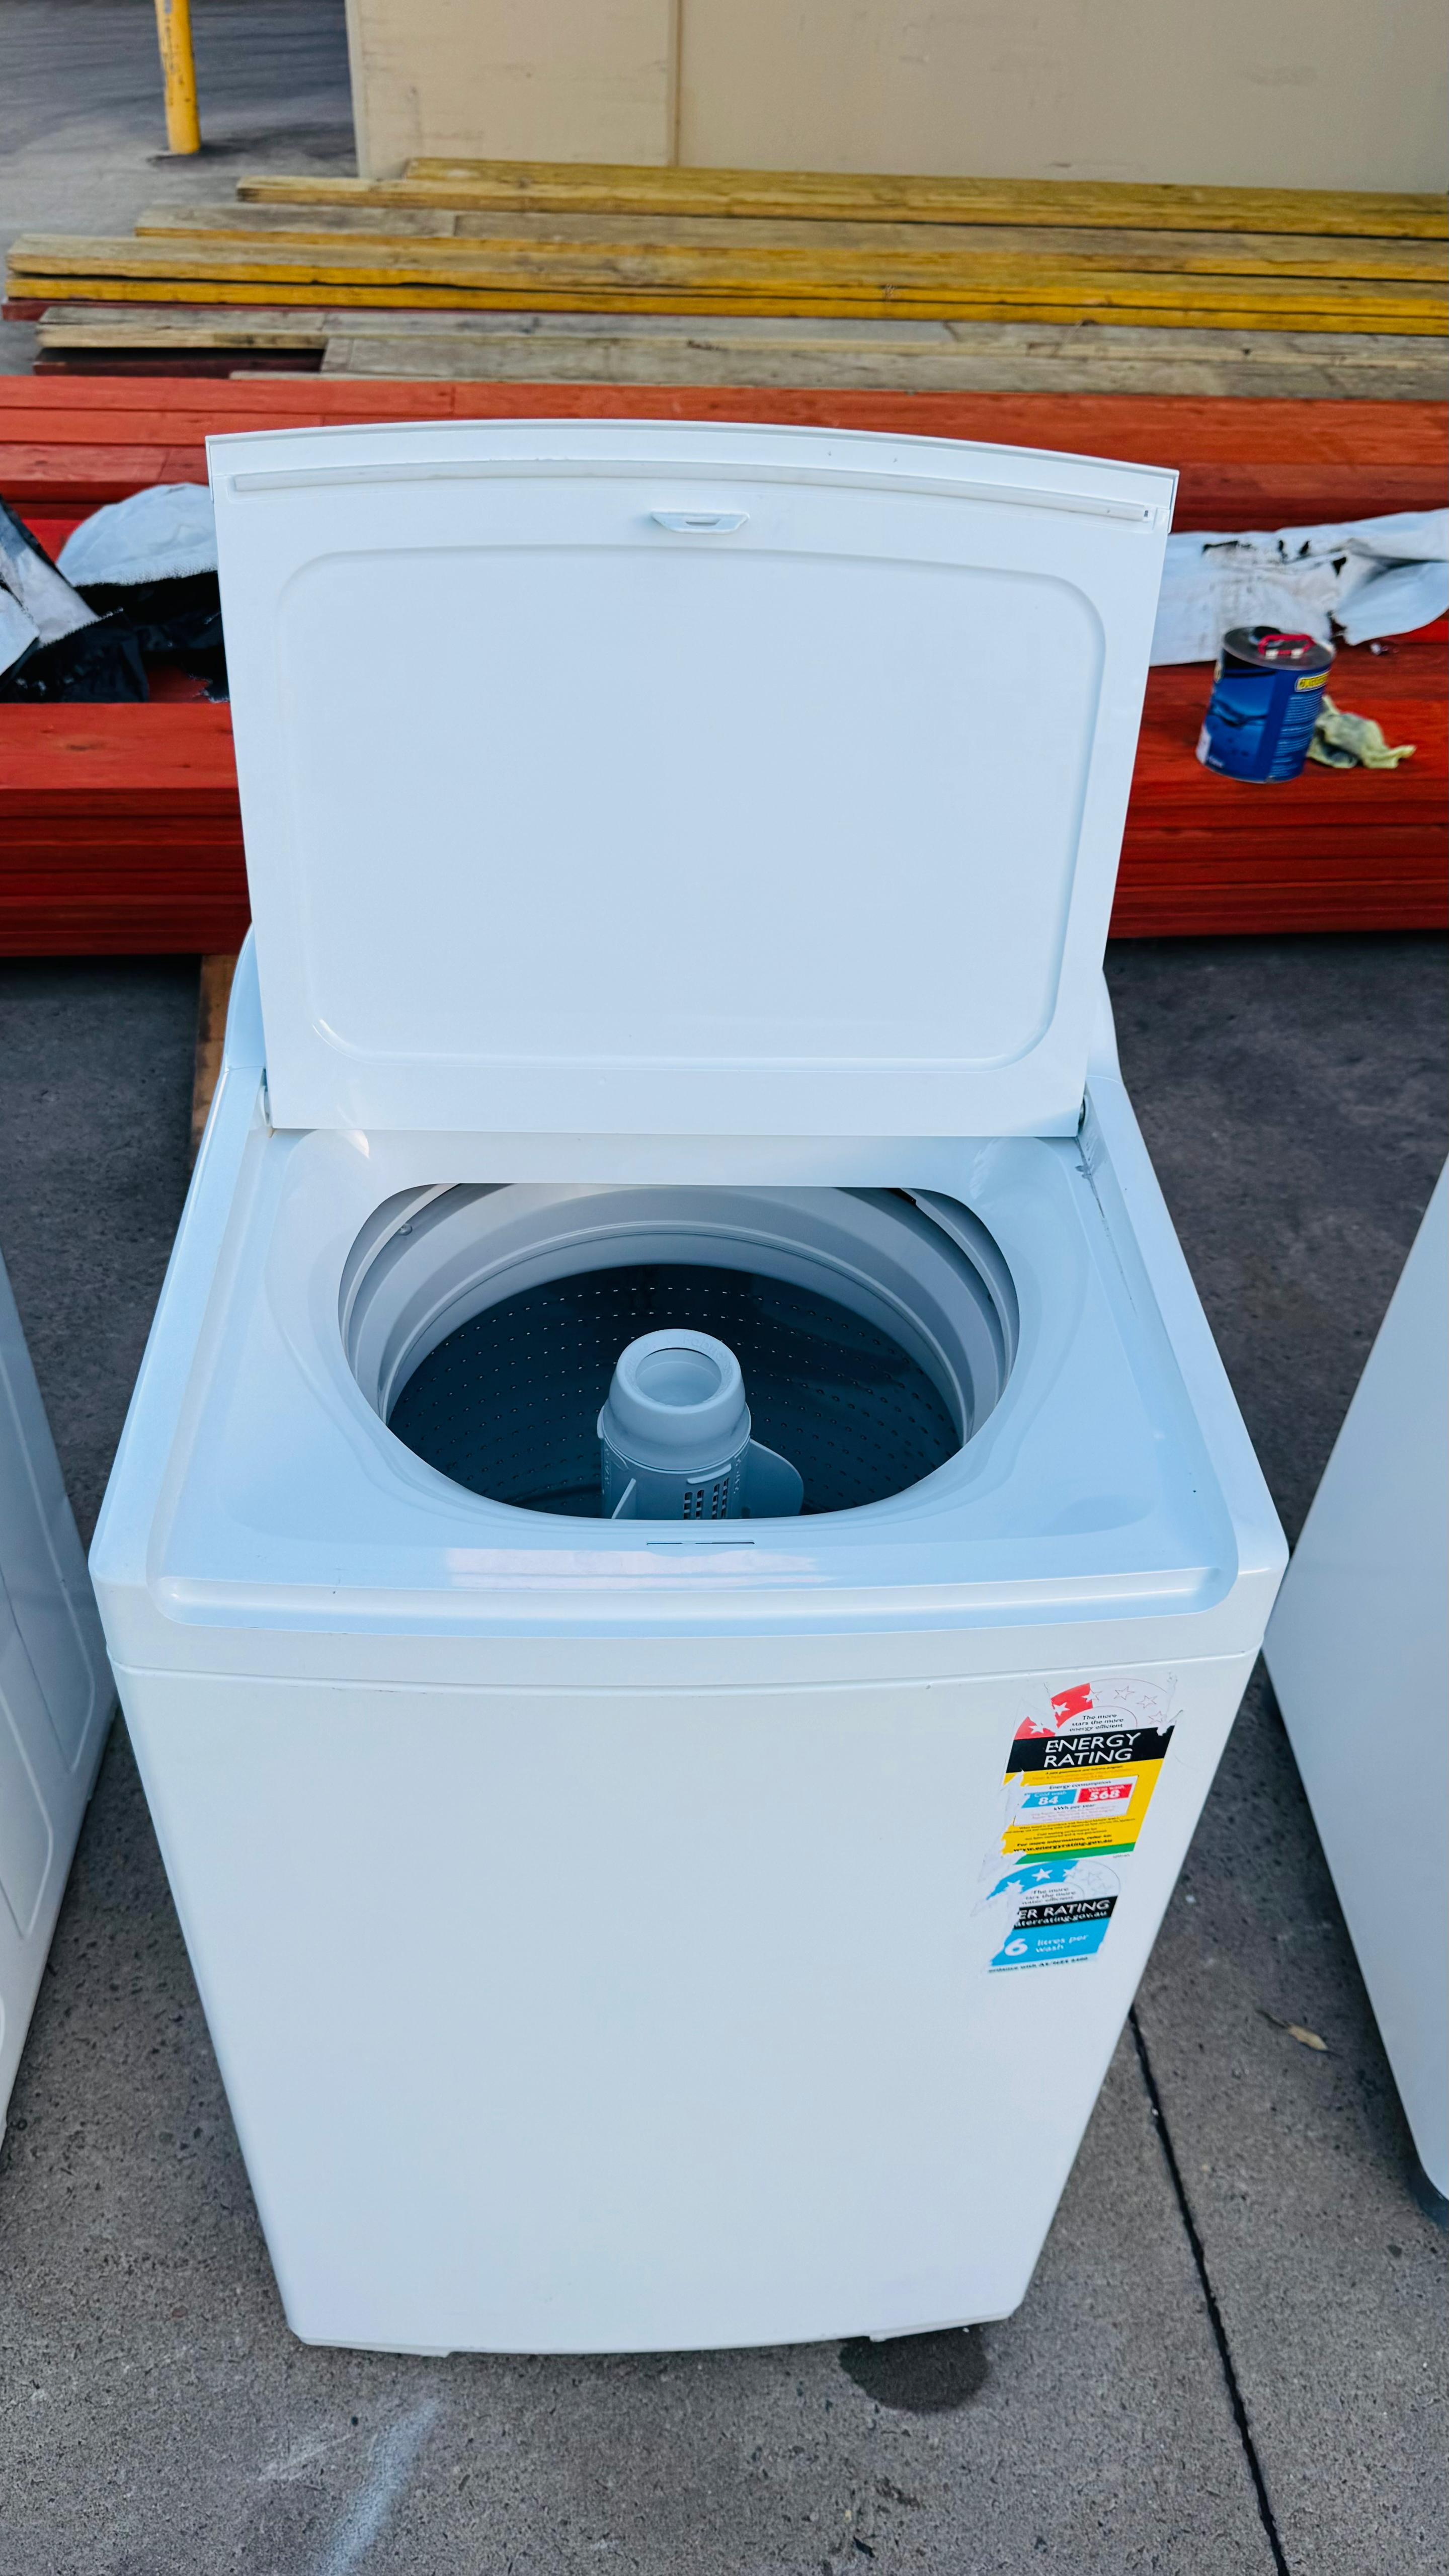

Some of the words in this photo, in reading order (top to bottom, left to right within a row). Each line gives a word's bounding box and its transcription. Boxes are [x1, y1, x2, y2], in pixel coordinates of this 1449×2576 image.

[1045, 1732, 1141, 1753] ENERGY
[1043, 1748, 1133, 1767] RATING
[1038, 1796, 1059, 1805] 84
[1089, 1789, 1120, 1801] 568
[1043, 1900, 1111, 1917] RATING
[1005, 1938, 1028, 1956] 6
[1035, 1944, 1064, 1953] wash
[1037, 1938, 1065, 1946] litres
[1069, 1935, 1089, 1944] per
